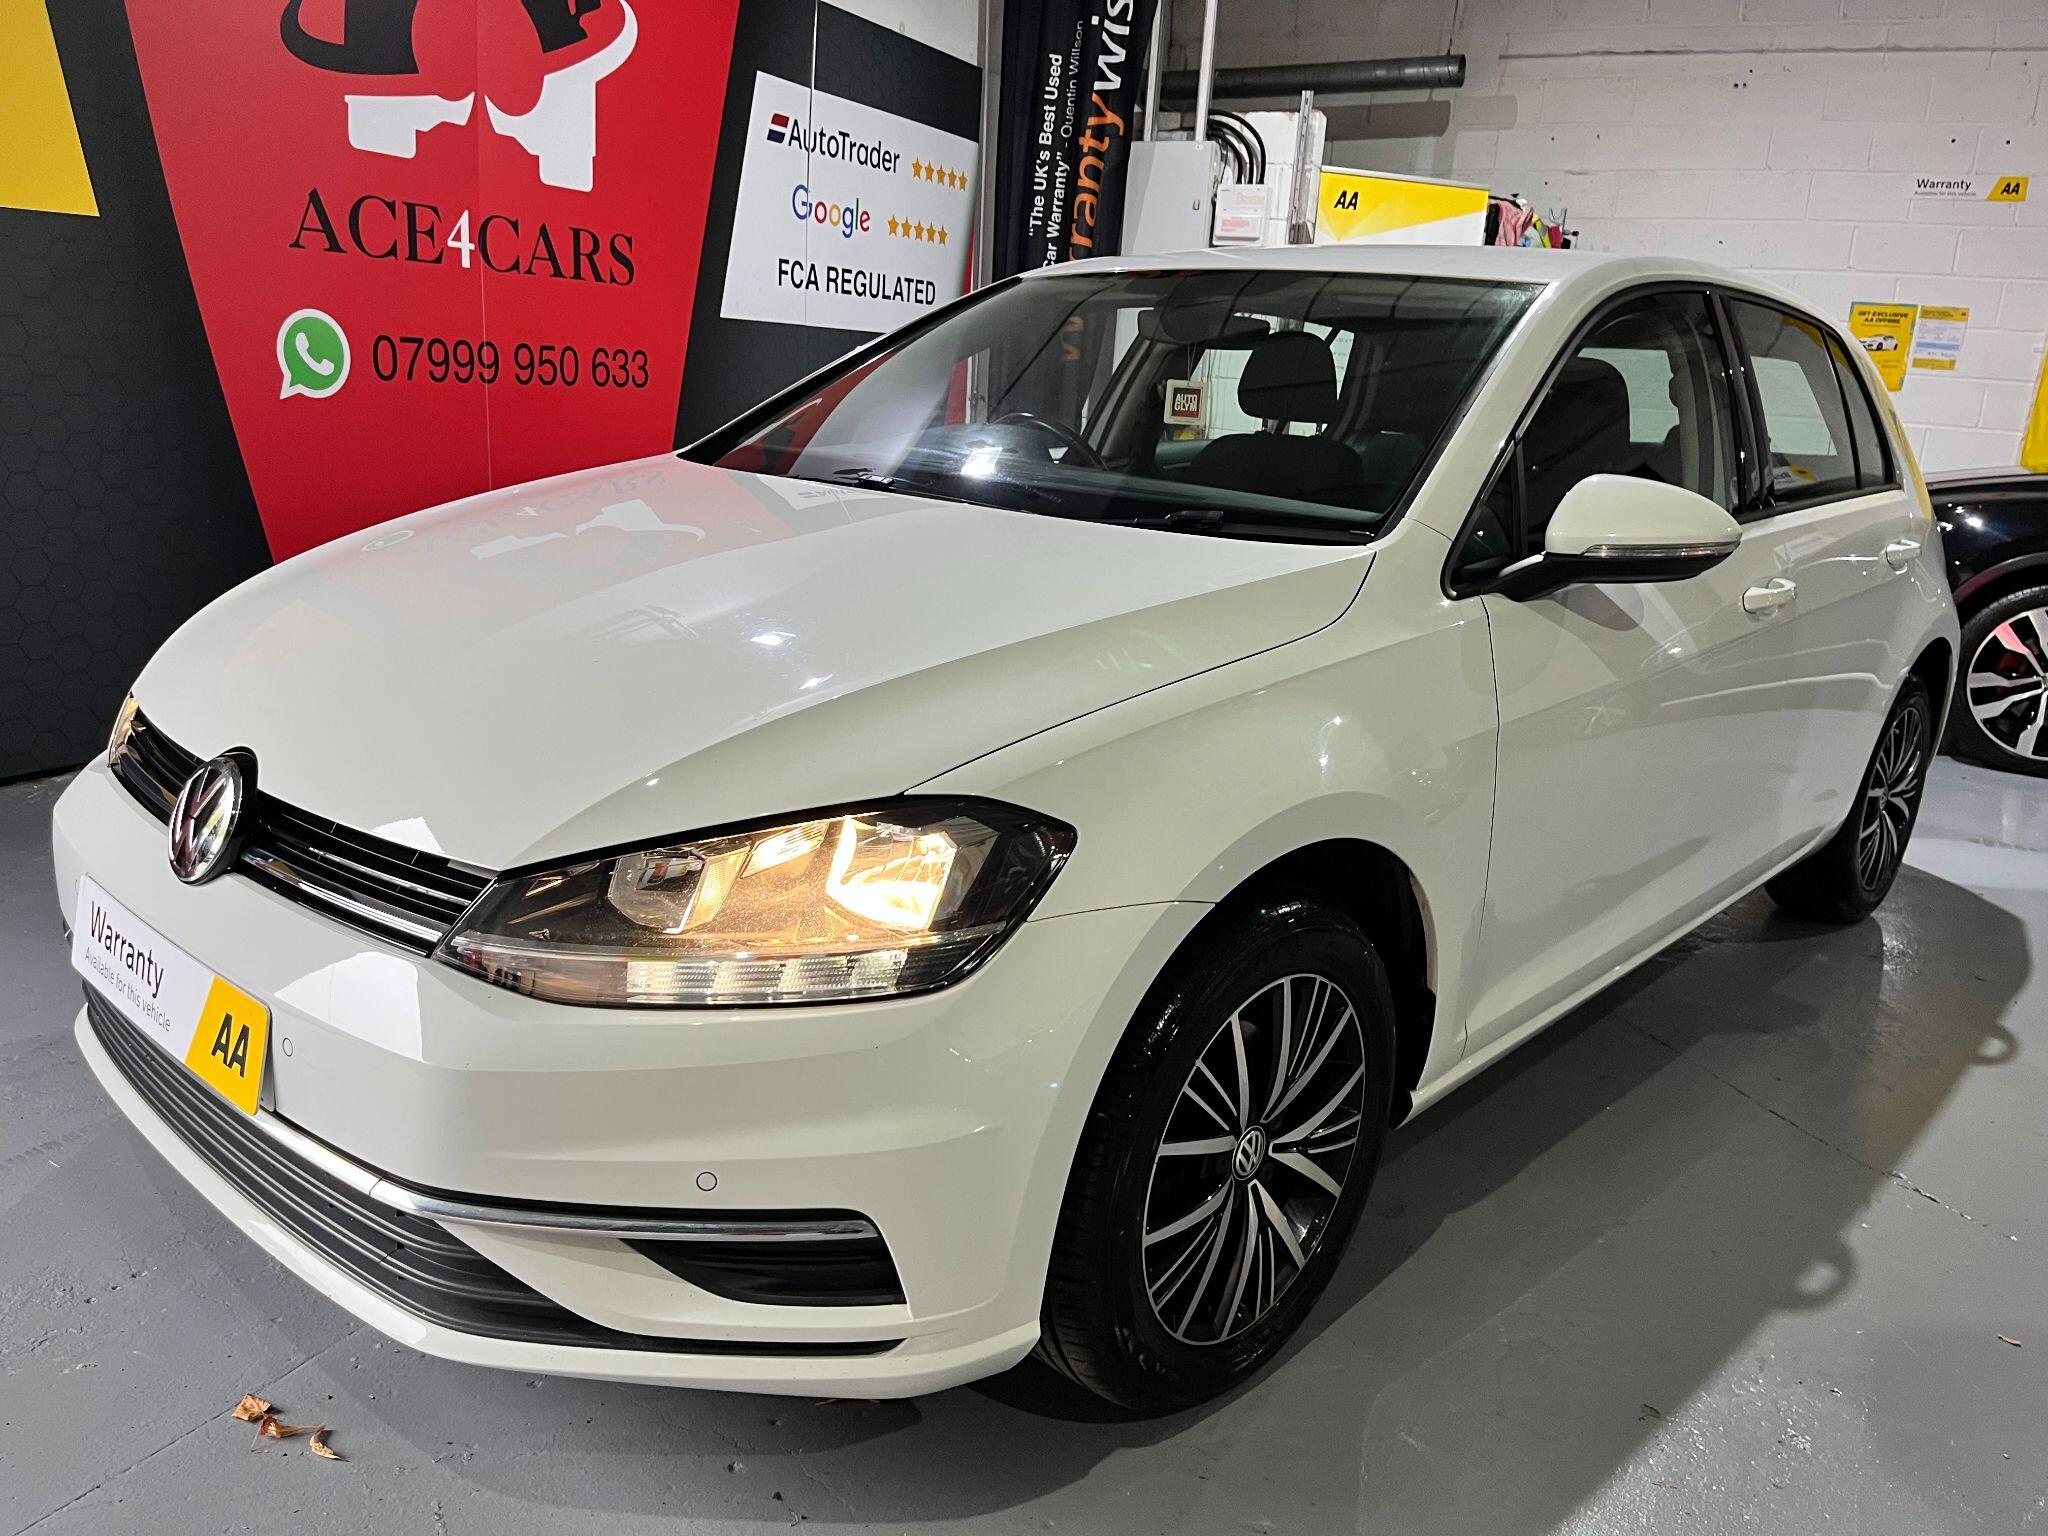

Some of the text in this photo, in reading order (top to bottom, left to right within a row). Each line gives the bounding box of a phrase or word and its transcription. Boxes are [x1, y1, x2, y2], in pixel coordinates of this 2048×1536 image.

[1044, 53, 1062, 100] Used
[1060, 79, 1077, 138] Quentin
[1069, 20, 1083, 75] Willson
[788, 118, 900, 174] AutoTrader
[1039, 104, 1056, 146] Best
[1068, 0, 1134, 262] rantywis
[791, 184, 871, 239] Google
[1333, 190, 1359, 211] AA
[1917, 178, 1971, 191] Warranty
[2001, 182, 2021, 195] AA
[288, 186, 636, 287] ACE4CARS
[778, 257, 936, 305] FCA REGULATED
[372, 334, 649, 389] 07999 950 633
[1176, 393, 1198, 402] AUTO
[91, 900, 164, 998] Warranty
[85, 946, 171, 1032] Available for this vehicle
[211, 1012, 250, 1078] AA
